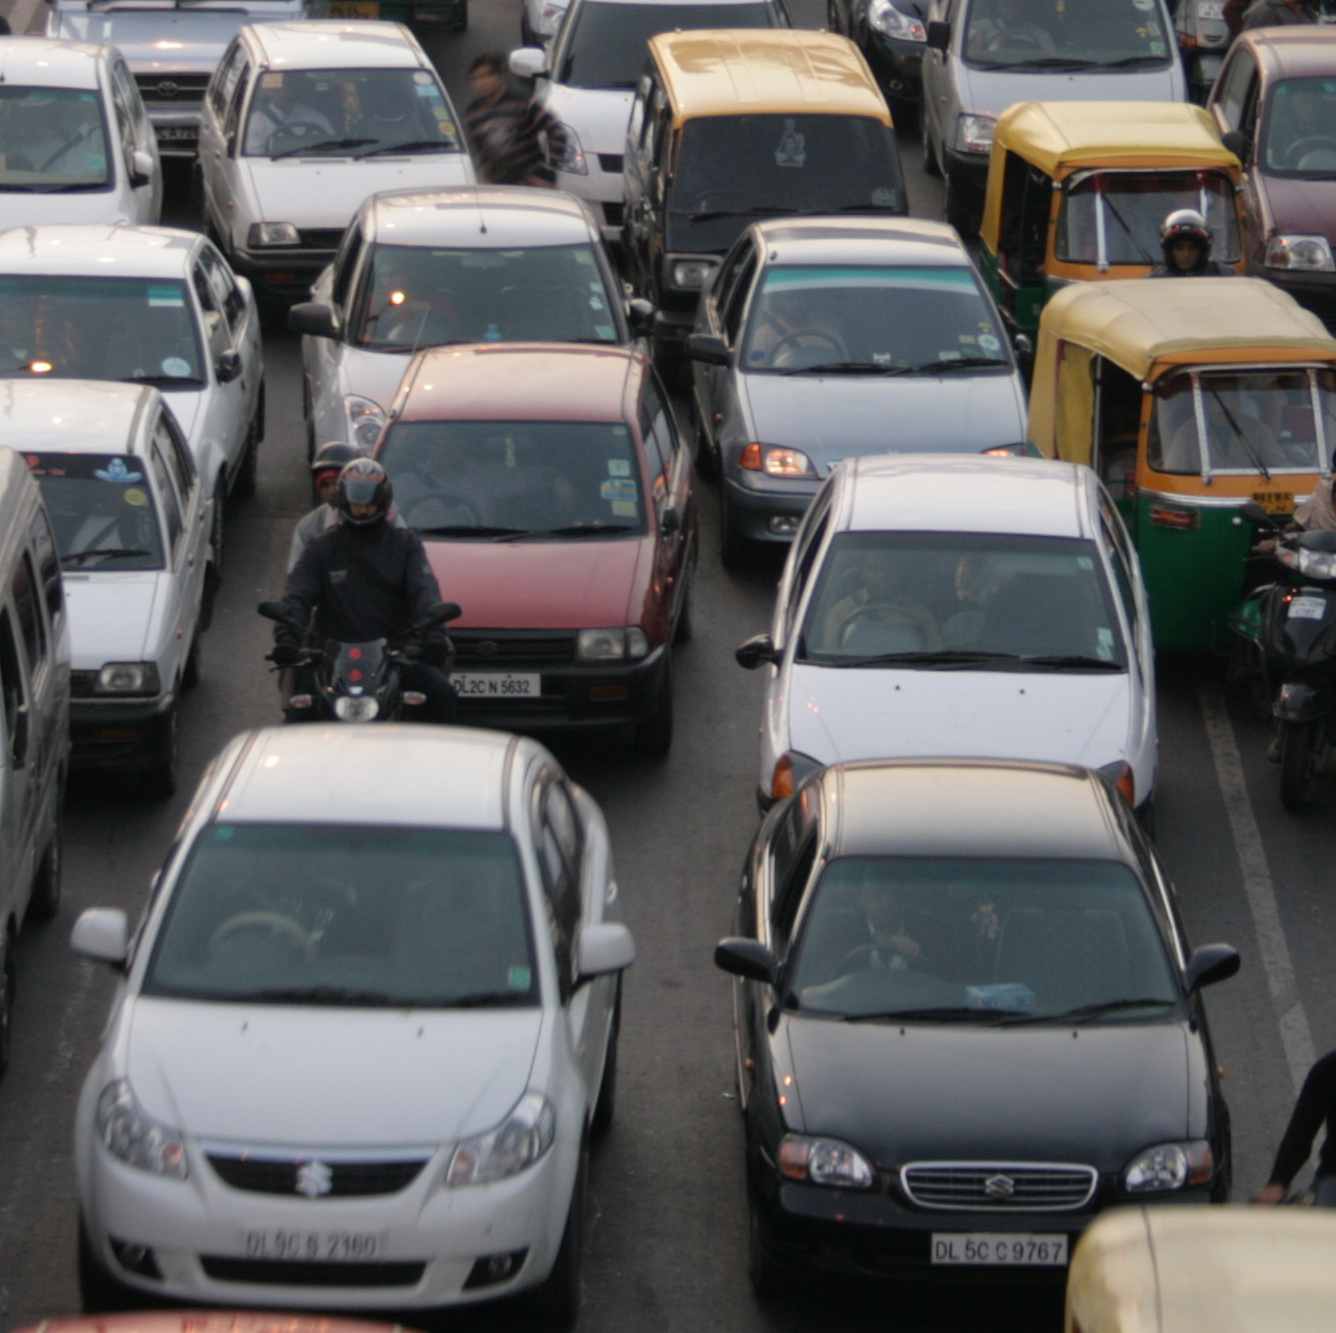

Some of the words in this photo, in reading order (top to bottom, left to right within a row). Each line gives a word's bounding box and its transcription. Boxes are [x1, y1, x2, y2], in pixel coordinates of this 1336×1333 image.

[501, 678, 531, 694] 5632
[935, 1242, 961, 1261] DL
[965, 1241, 989, 1261] 5C
[1013, 1241, 1063, 1261] 9767
